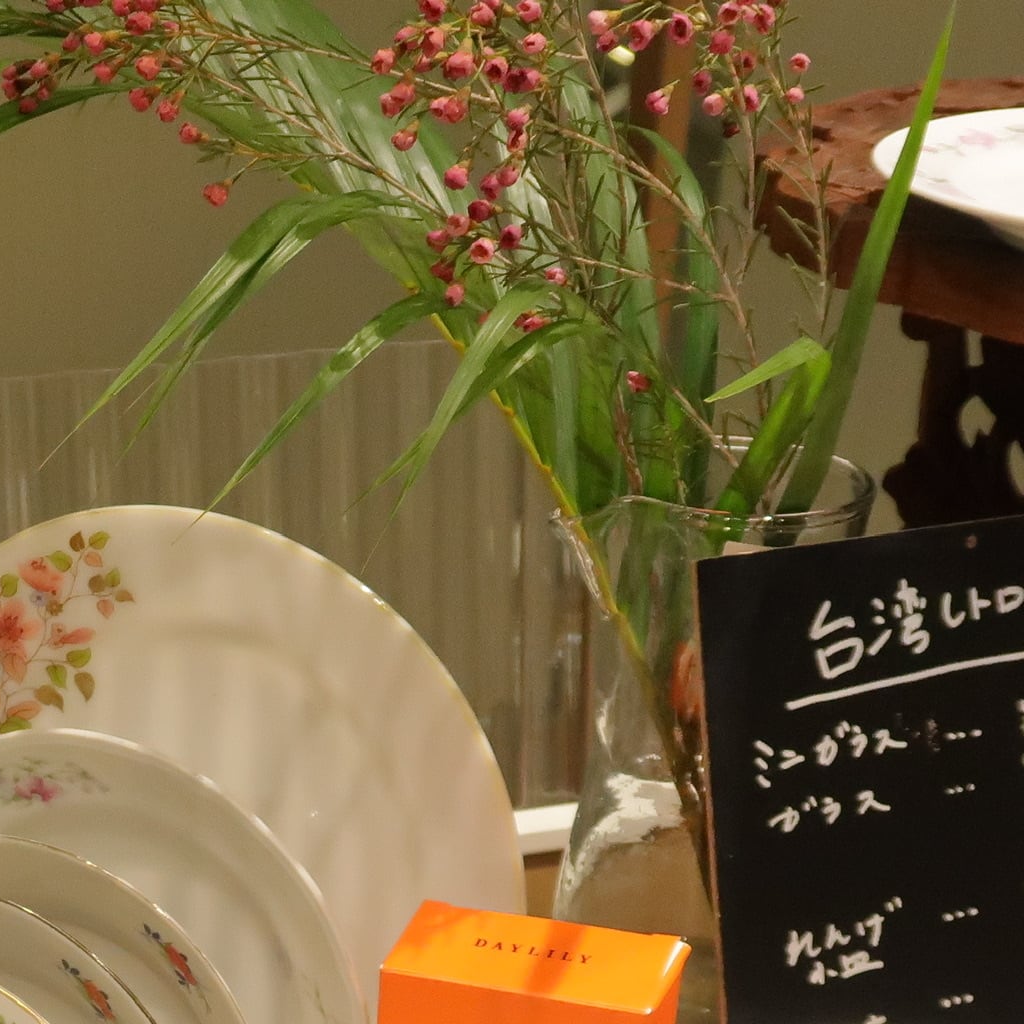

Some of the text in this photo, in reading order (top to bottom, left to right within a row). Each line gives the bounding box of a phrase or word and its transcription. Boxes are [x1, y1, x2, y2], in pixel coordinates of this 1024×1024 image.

[785, 896, 903, 966] れんげ
[474, 938, 592, 964] DAYLILY
[807, 950, 885, 985] 小皿
